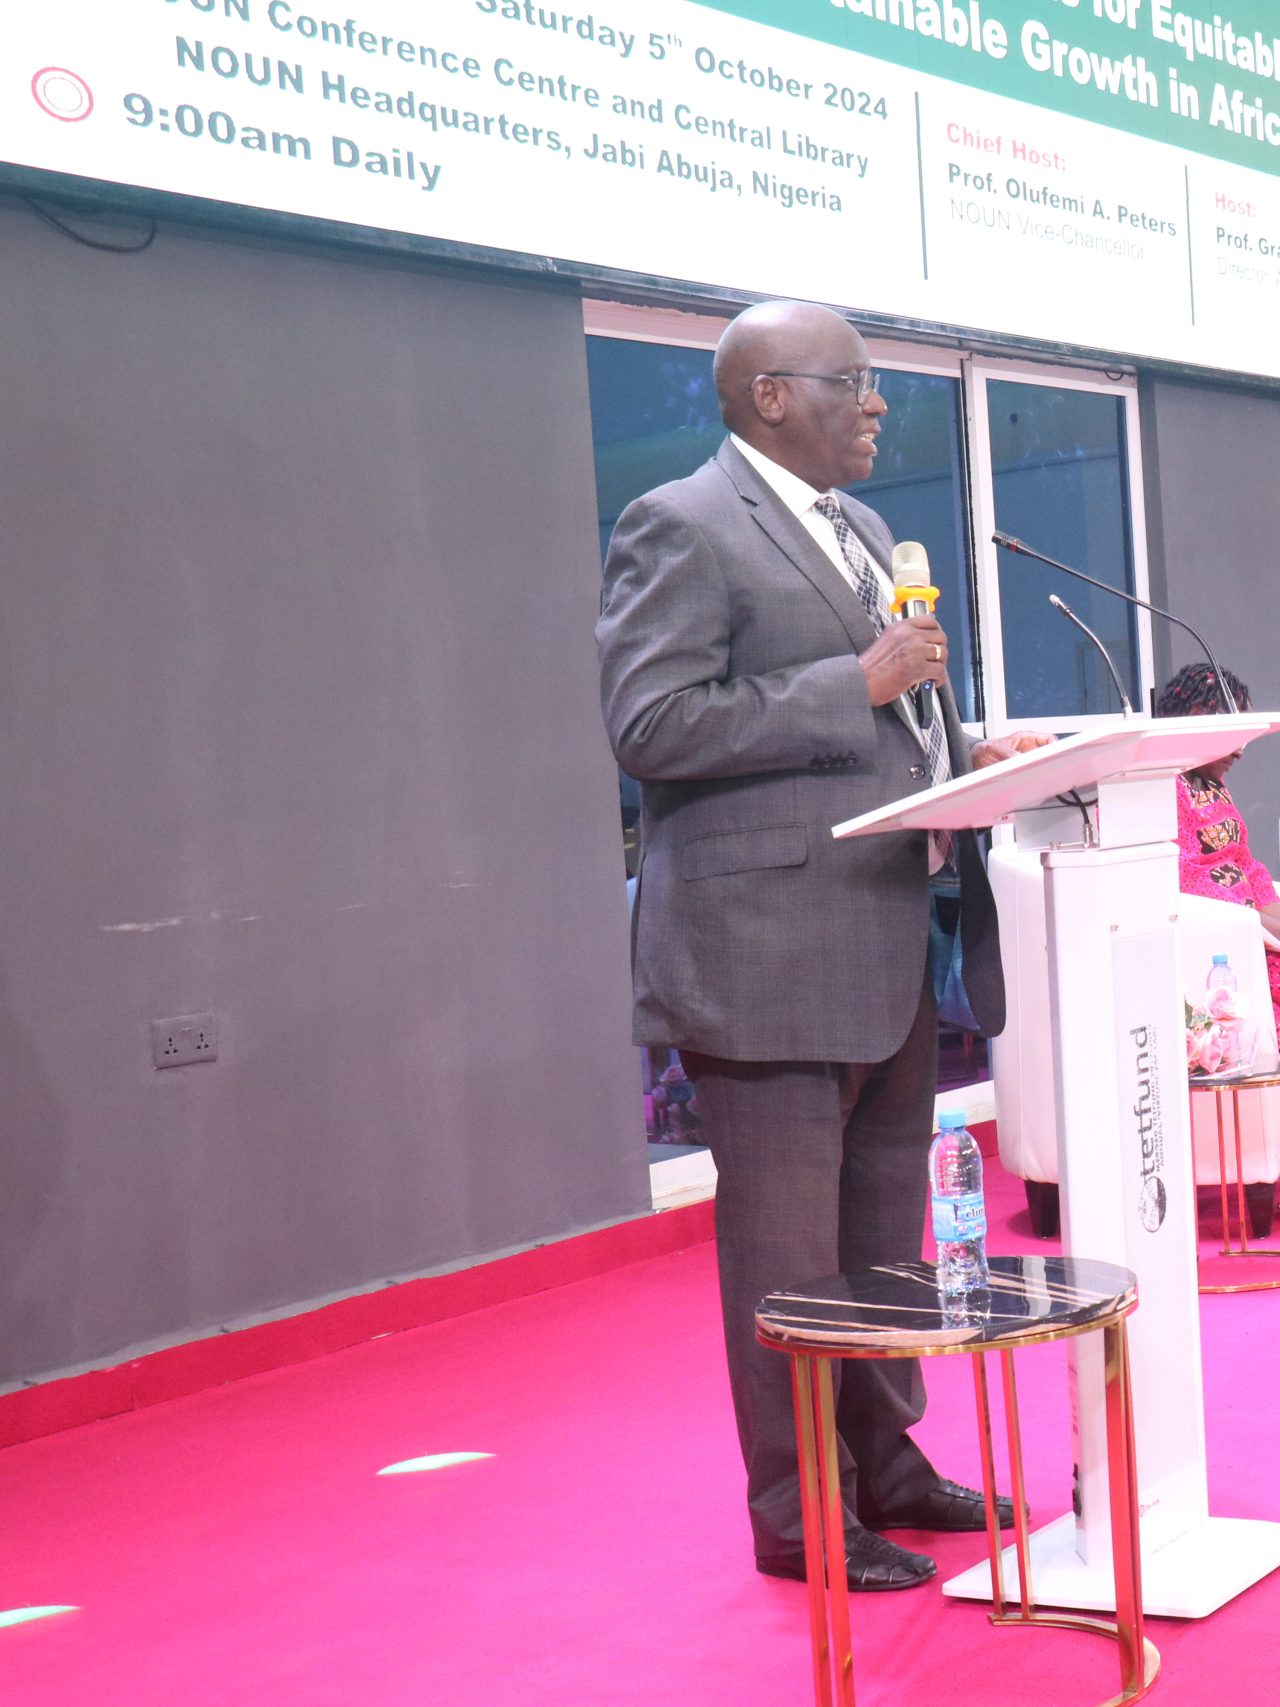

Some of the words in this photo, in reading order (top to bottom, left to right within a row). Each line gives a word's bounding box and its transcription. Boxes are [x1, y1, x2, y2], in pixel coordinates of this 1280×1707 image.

[267, 0, 482, 79] Conference
[494, 57, 601, 109] Centre
[611, 92, 665, 124] and
[674, 104, 772, 151] Central
[781, 130, 869, 179] Library
[648, 31, 683, 61] 5th
[694, 46, 814, 100] October
[823, 82, 889, 121] 2024
[1020, 19, 1159, 108] Growth
[1168, 68, 1201, 121] in
[122, 92, 312, 161] 9:00am
[331, 135, 442, 193] Daily
[175, 34, 305, 95] NOUN
[320, 70, 572, 159] Headquarters,
[582, 132, 646, 170] Jabi
[656, 149, 743, 197] Abuja,
[751, 170, 843, 213] Nigeria
[947, 122, 1003, 155] Chief
[1011, 139, 1067, 172] Host:
[947, 162, 998, 194] Prof.
[1005, 177, 1086, 215] Olufemi
[1092, 199, 1112, 221] A.
[1116, 204, 1178, 237] Peters
[950, 197, 1011, 232] NOUN
[1214, 191, 1257, 219] Host:
[1216, 226, 1253, 252] Prof.
